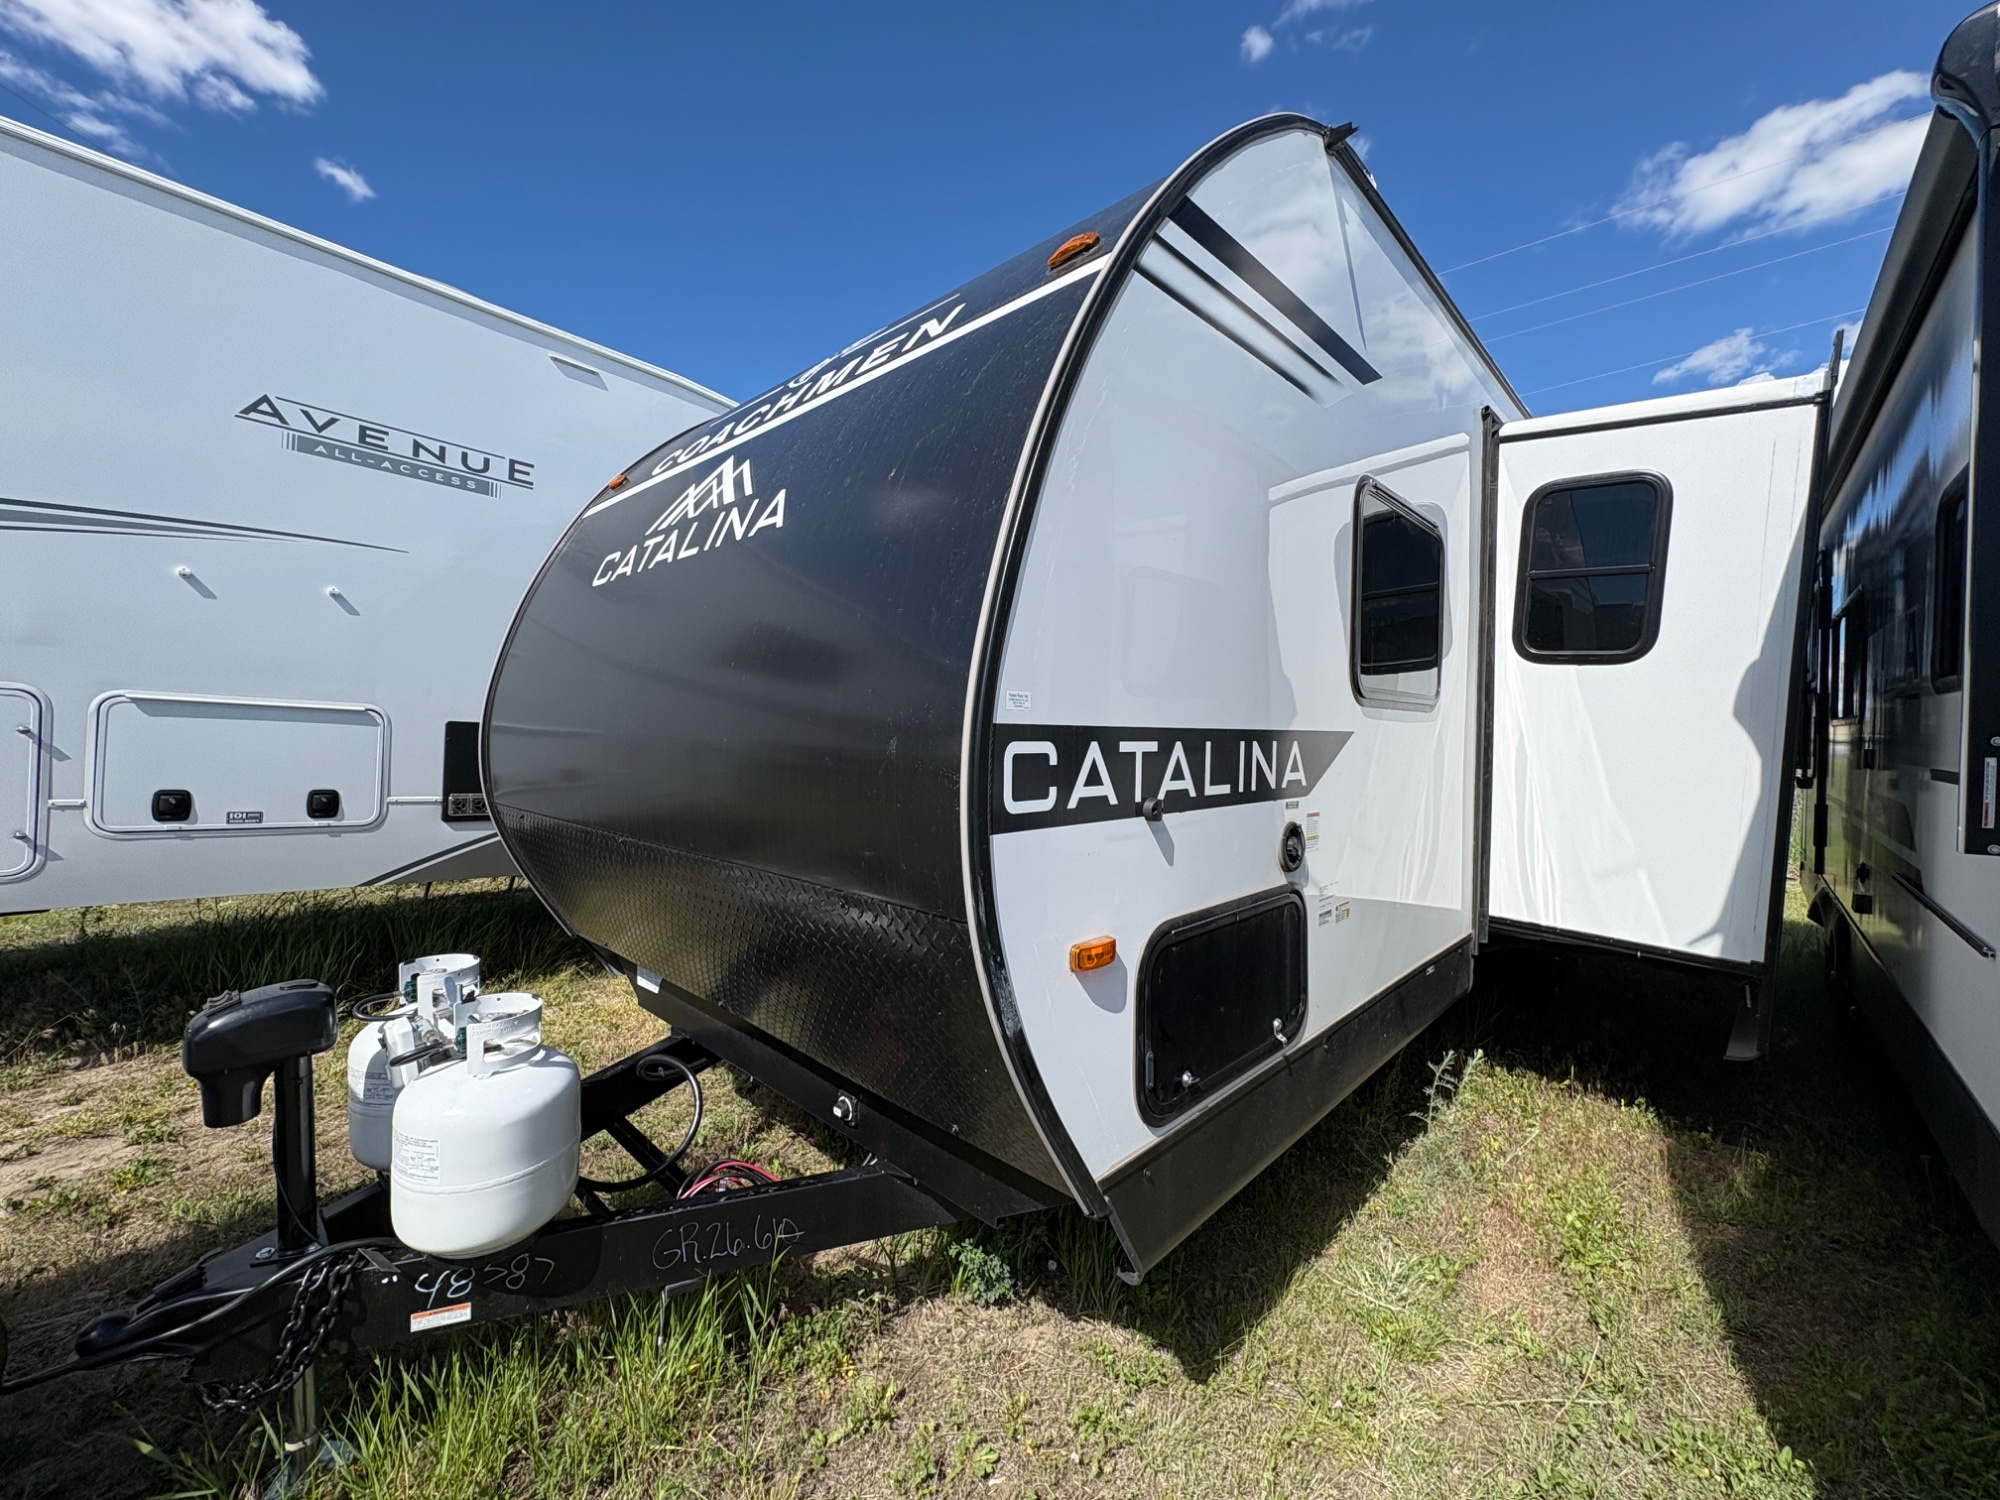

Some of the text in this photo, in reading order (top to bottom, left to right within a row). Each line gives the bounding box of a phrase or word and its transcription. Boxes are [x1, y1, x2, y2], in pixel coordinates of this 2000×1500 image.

[651, 302, 966, 476] COACHMEN
[238, 393, 535, 487] AVENUE
[314, 444, 477, 489] ALL-ACCESS
[592, 488, 787, 587] CATALINA
[1002, 740, 1308, 815] CATALINA
